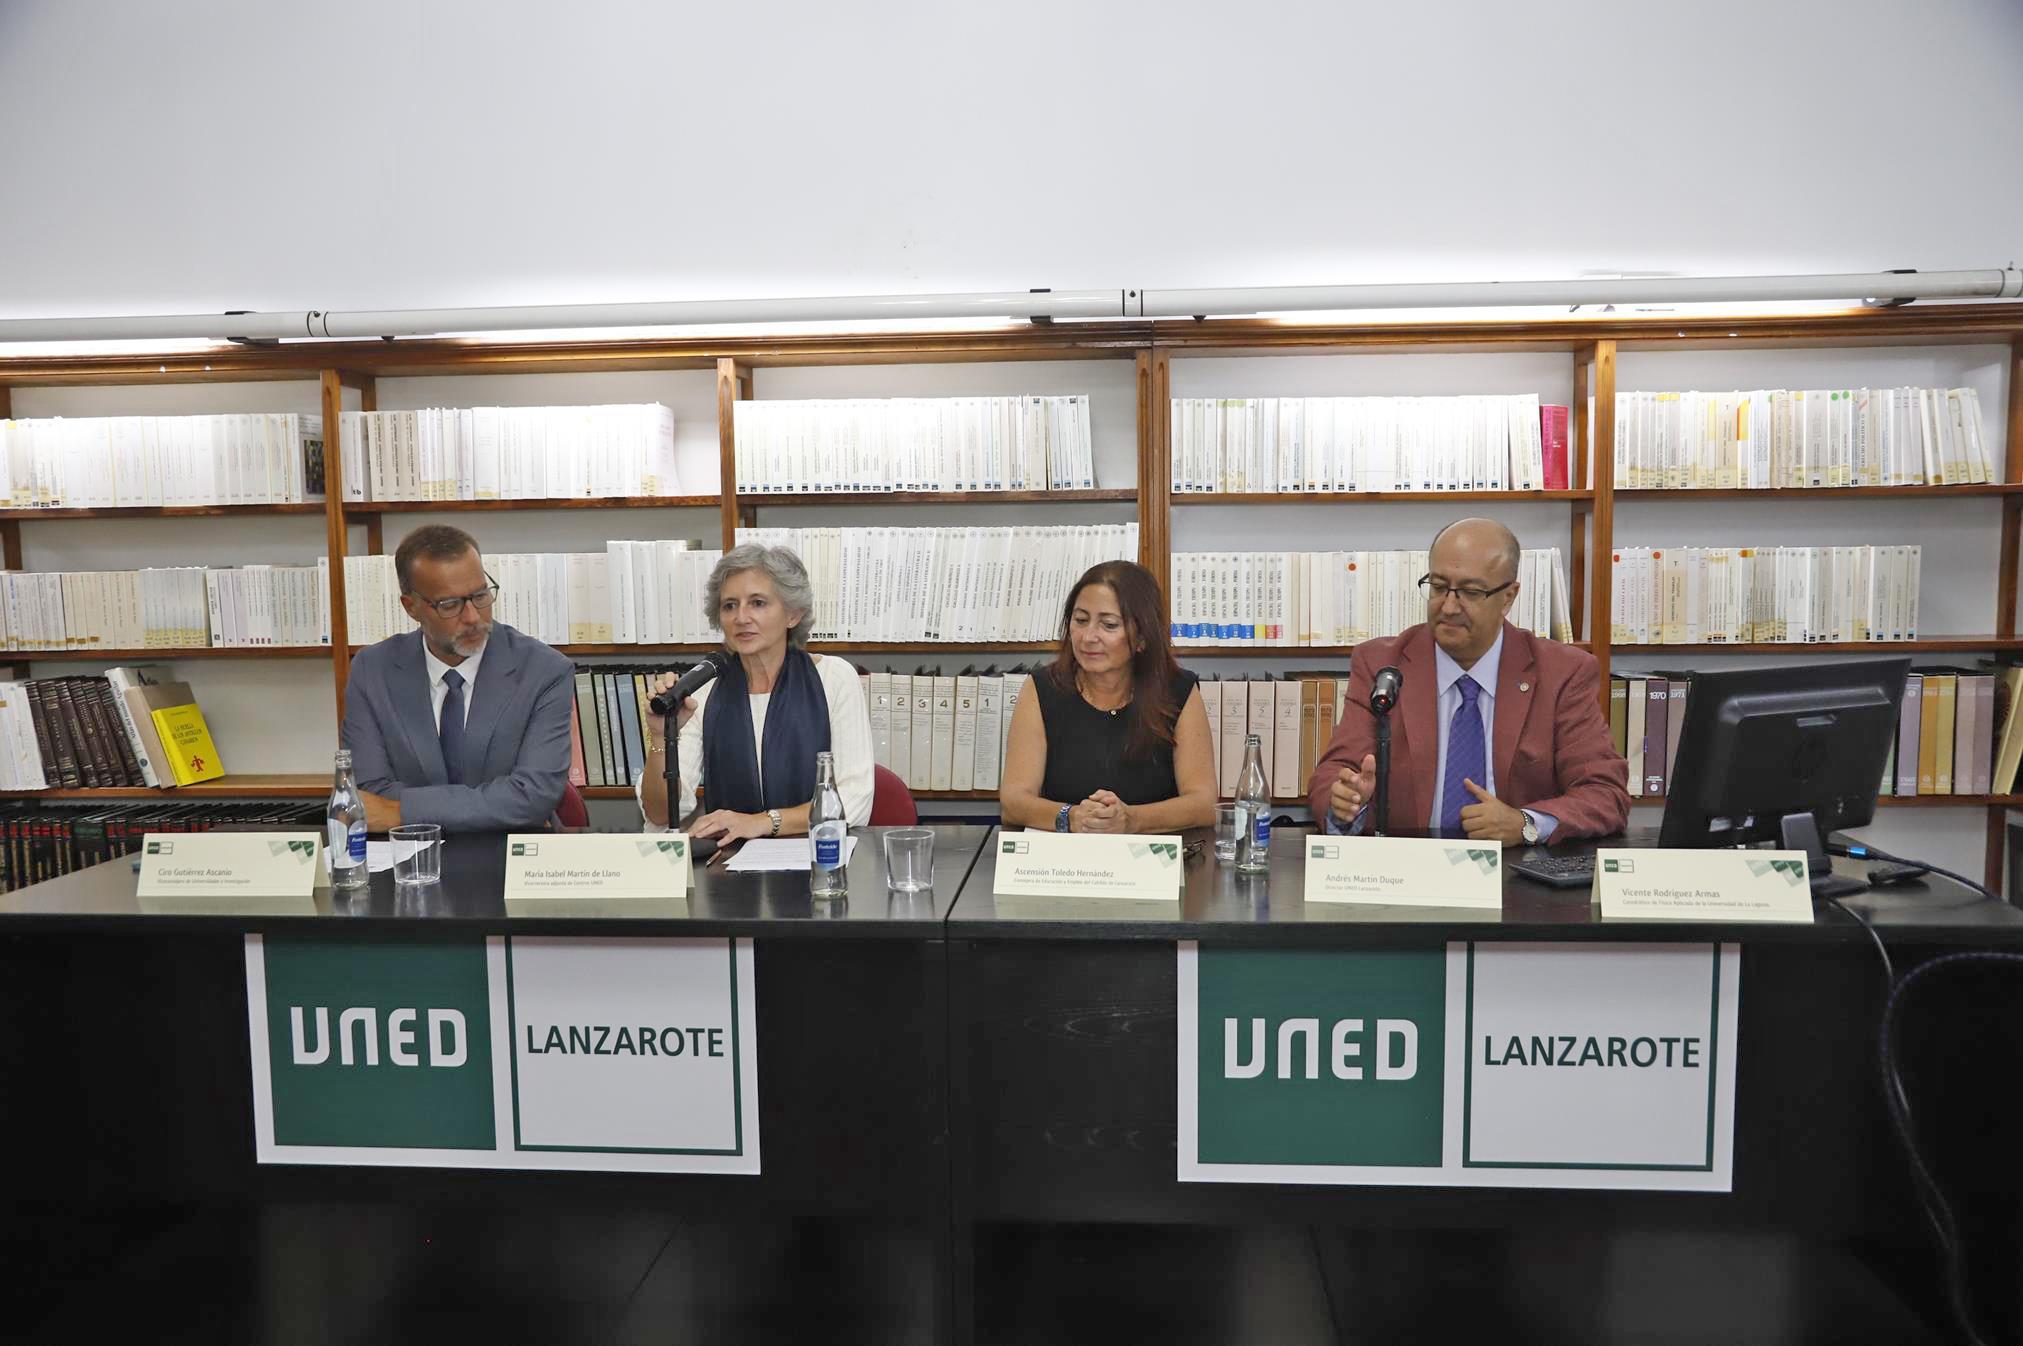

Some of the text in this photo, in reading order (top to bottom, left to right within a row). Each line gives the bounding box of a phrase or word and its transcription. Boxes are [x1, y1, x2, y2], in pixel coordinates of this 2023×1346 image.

[897, 697, 904, 706] 2
[918, 699, 926, 708] 3
[940, 699, 948, 708] 4
[963, 699, 970, 708] 5
[984, 698, 989, 706] 1
[1010, 695, 1017, 705] 2
[174, 868, 204, 876] Gutiérrez
[1015, 868, 1113, 878] Ascensión Toledo Hernández
[1326, 874, 1350, 882] Andrés
[1380, 876, 1404, 886] Duque
[1622, 889, 1651, 897] Vicente
[1695, 890, 1720, 898] Armas
[290, 1007, 468, 1066] UNED
[528, 1025, 724, 1056] LANZAROTE
[1225, 1018, 1418, 1080] UNED
[1485, 1036, 1700, 1068] LANZAROTE
